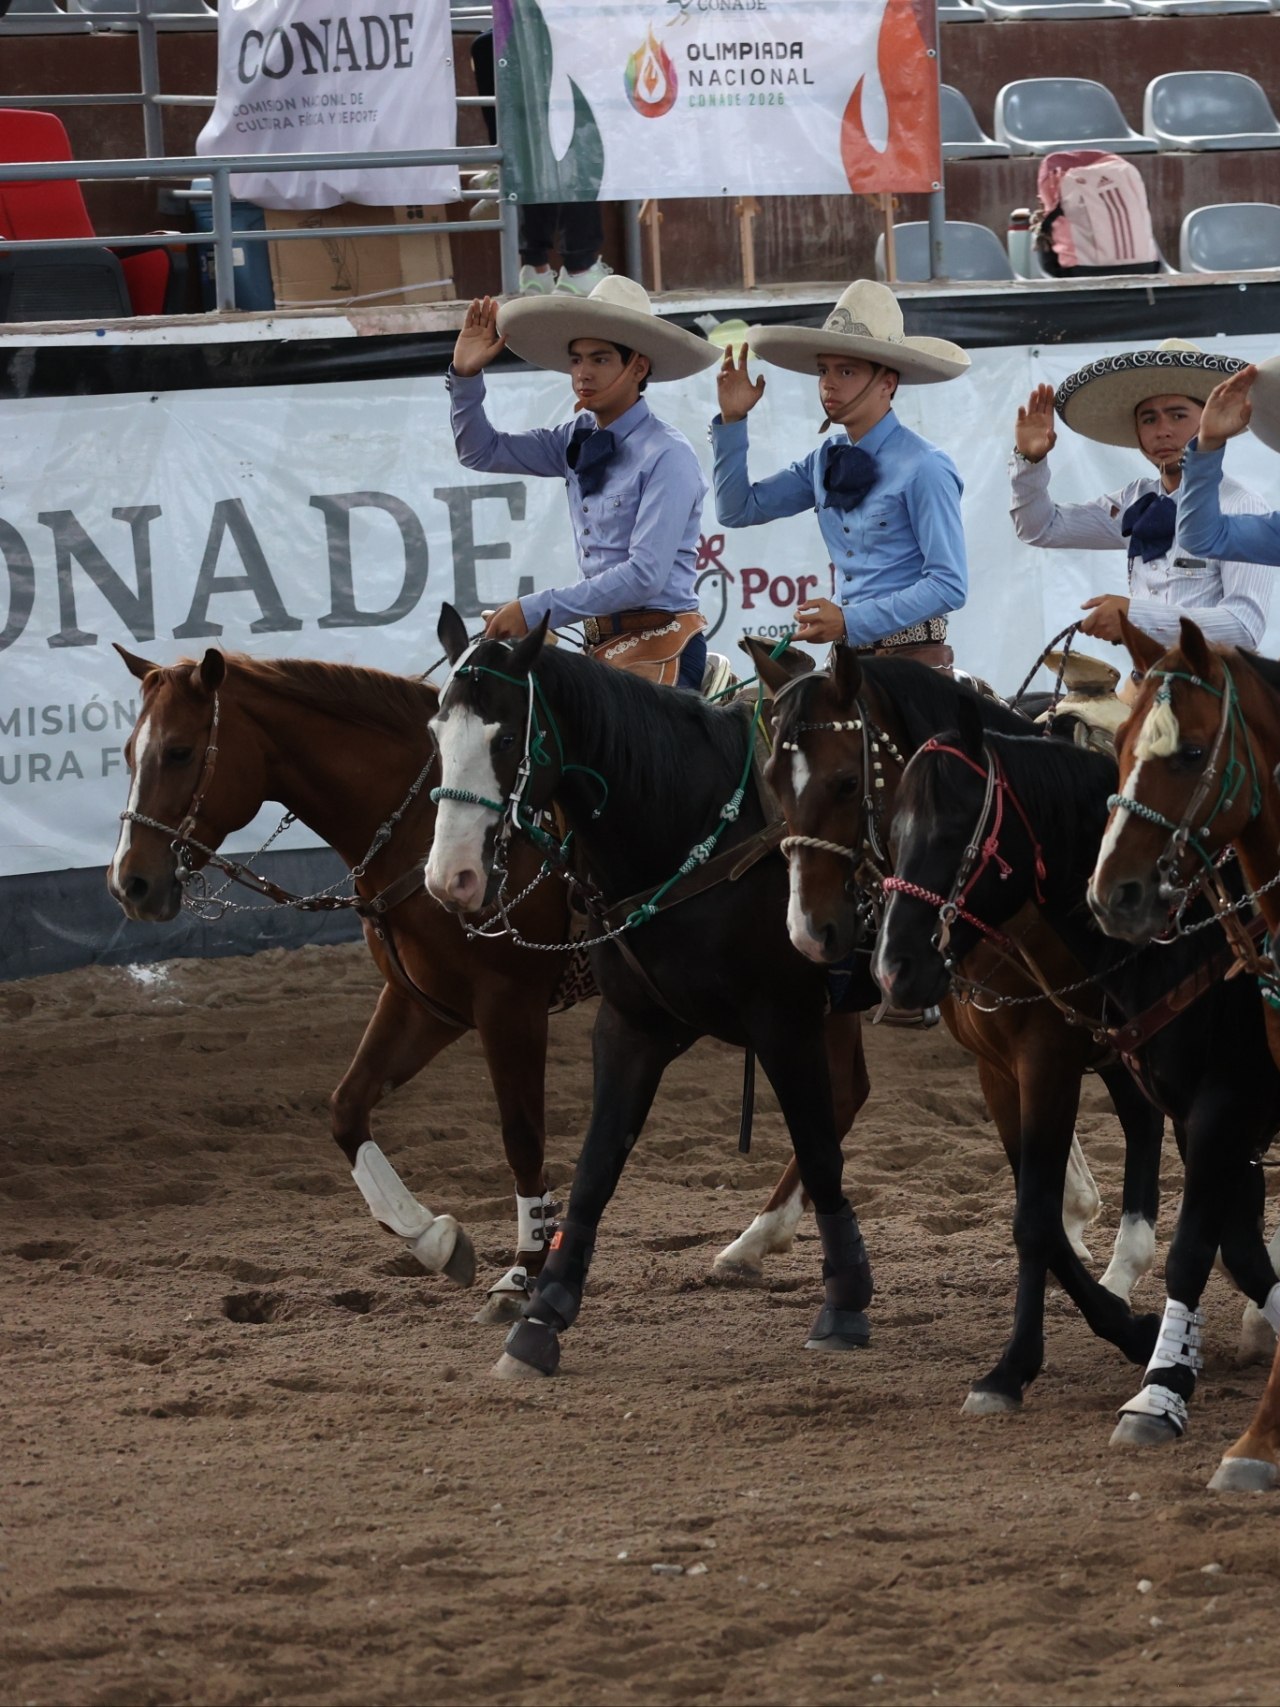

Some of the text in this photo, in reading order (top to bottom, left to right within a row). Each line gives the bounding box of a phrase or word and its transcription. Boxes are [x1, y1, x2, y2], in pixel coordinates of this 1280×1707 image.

[237, 13, 414, 84] CONADE
[687, 41, 804, 61] OLIMPIADA
[688, 68, 815, 87] NACIONAL
[351, 92, 364, 105] DE
[688, 92, 785, 108] CONADE 2026
[329, 111, 336, 125] Y
[740, 567, 818, 610] Por
